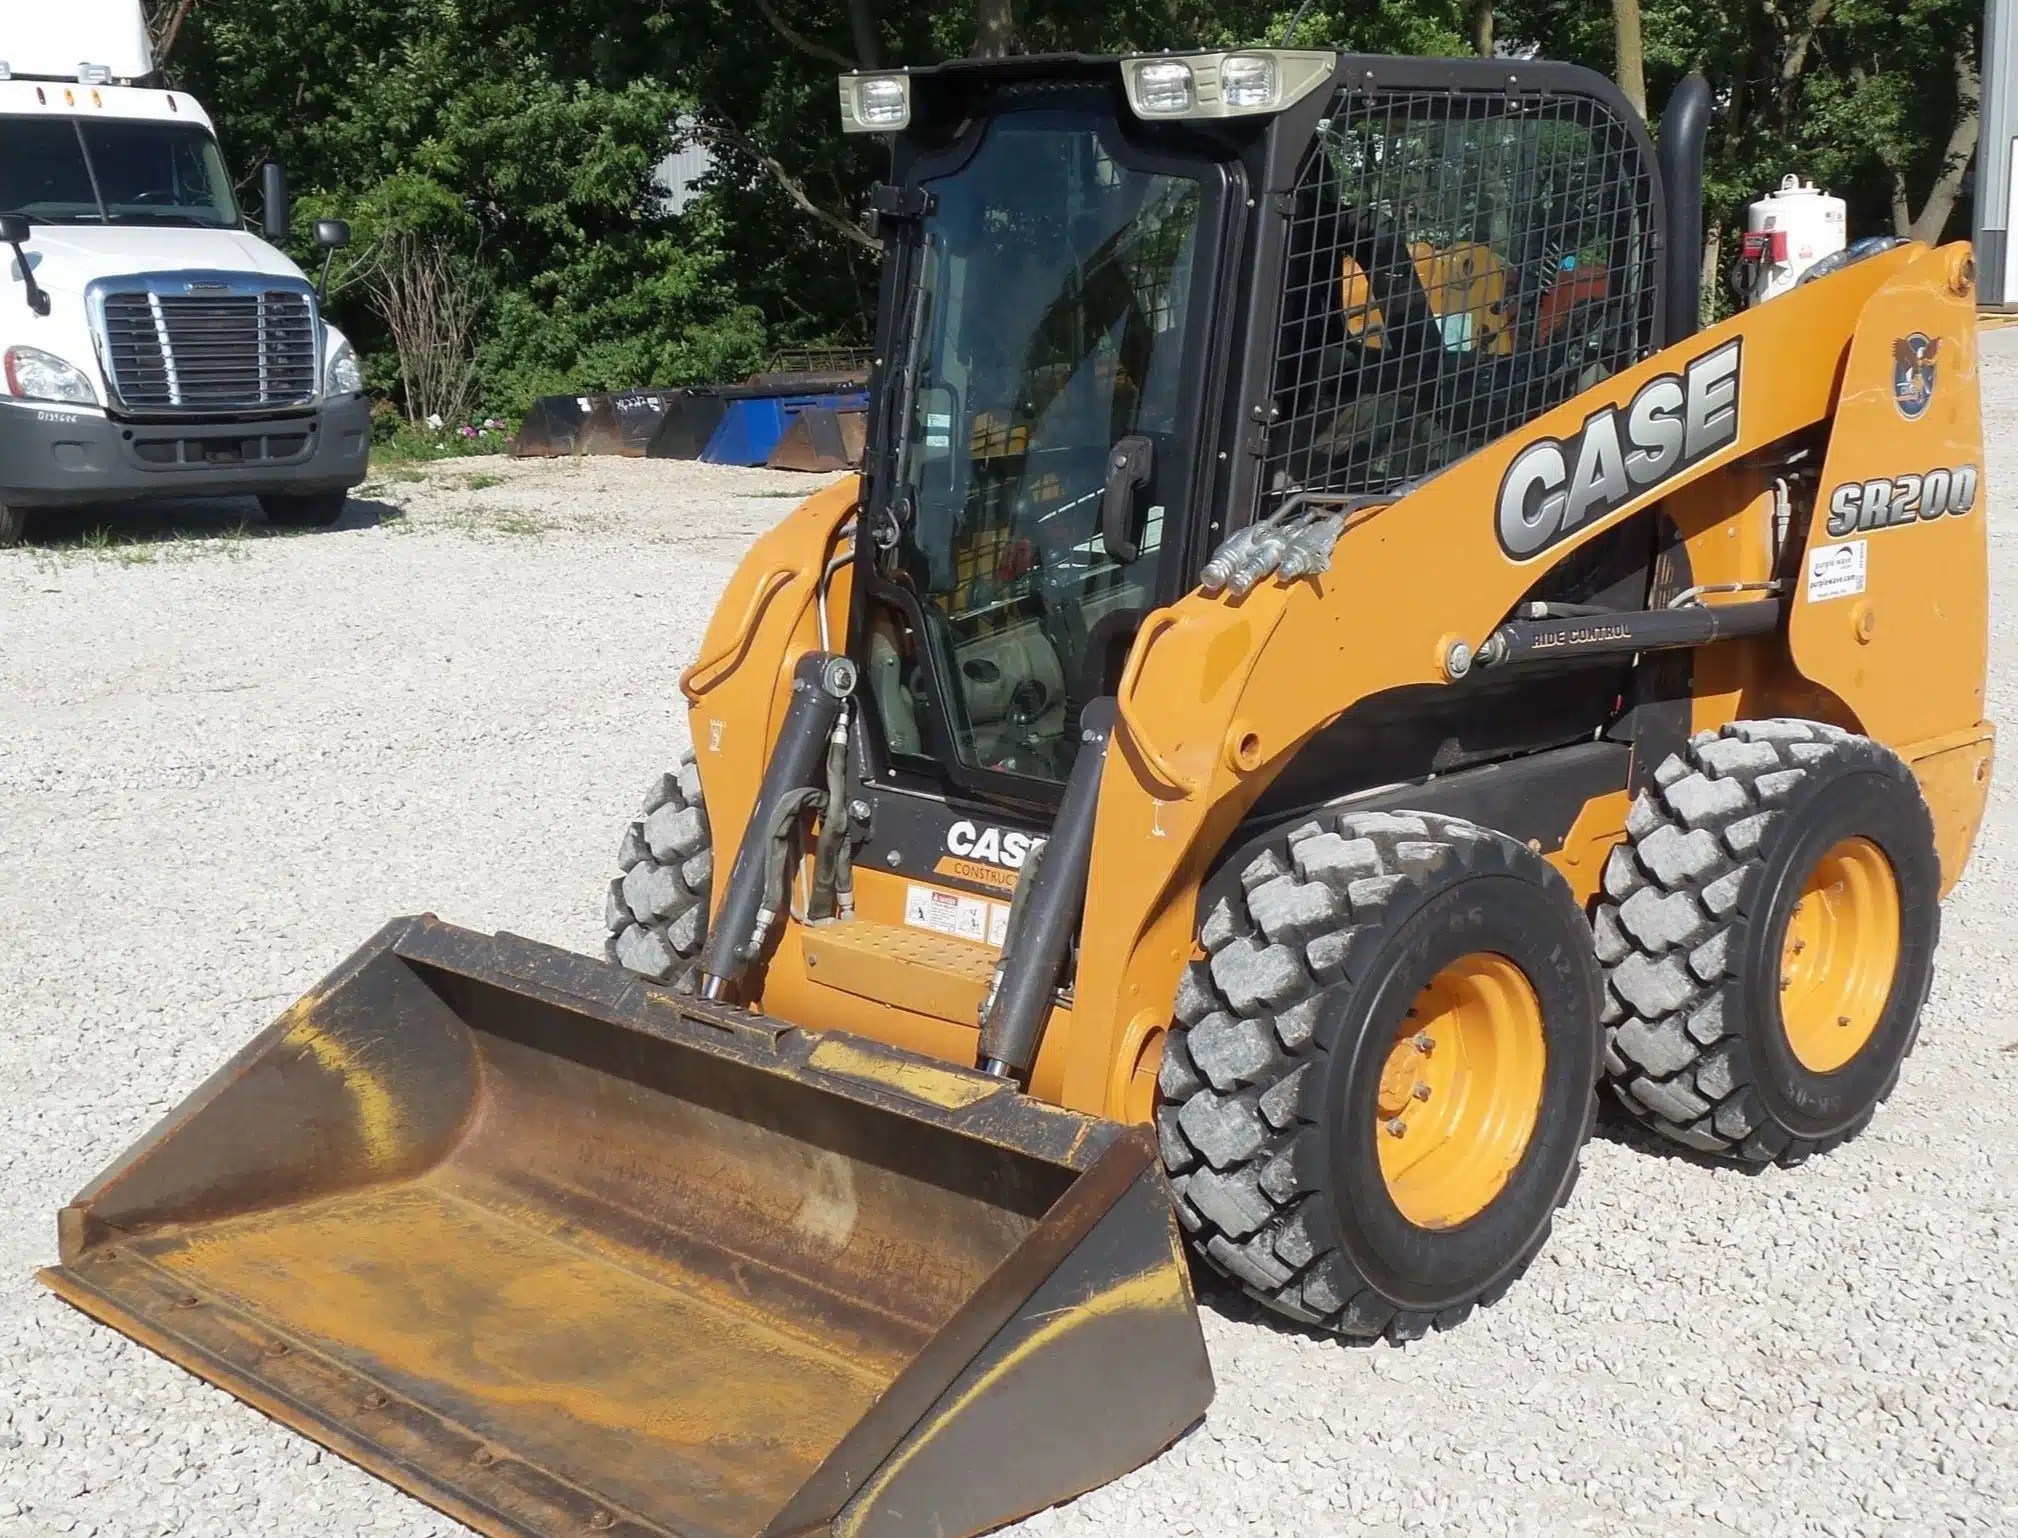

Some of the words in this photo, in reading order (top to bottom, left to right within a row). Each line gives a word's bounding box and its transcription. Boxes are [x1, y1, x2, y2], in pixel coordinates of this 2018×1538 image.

[1496, 336, 1742, 561] CASE
[1827, 464, 1977, 537] SR200
[1532, 630, 1565, 648] RIDE
[1568, 624, 1632, 644] CONTROL
